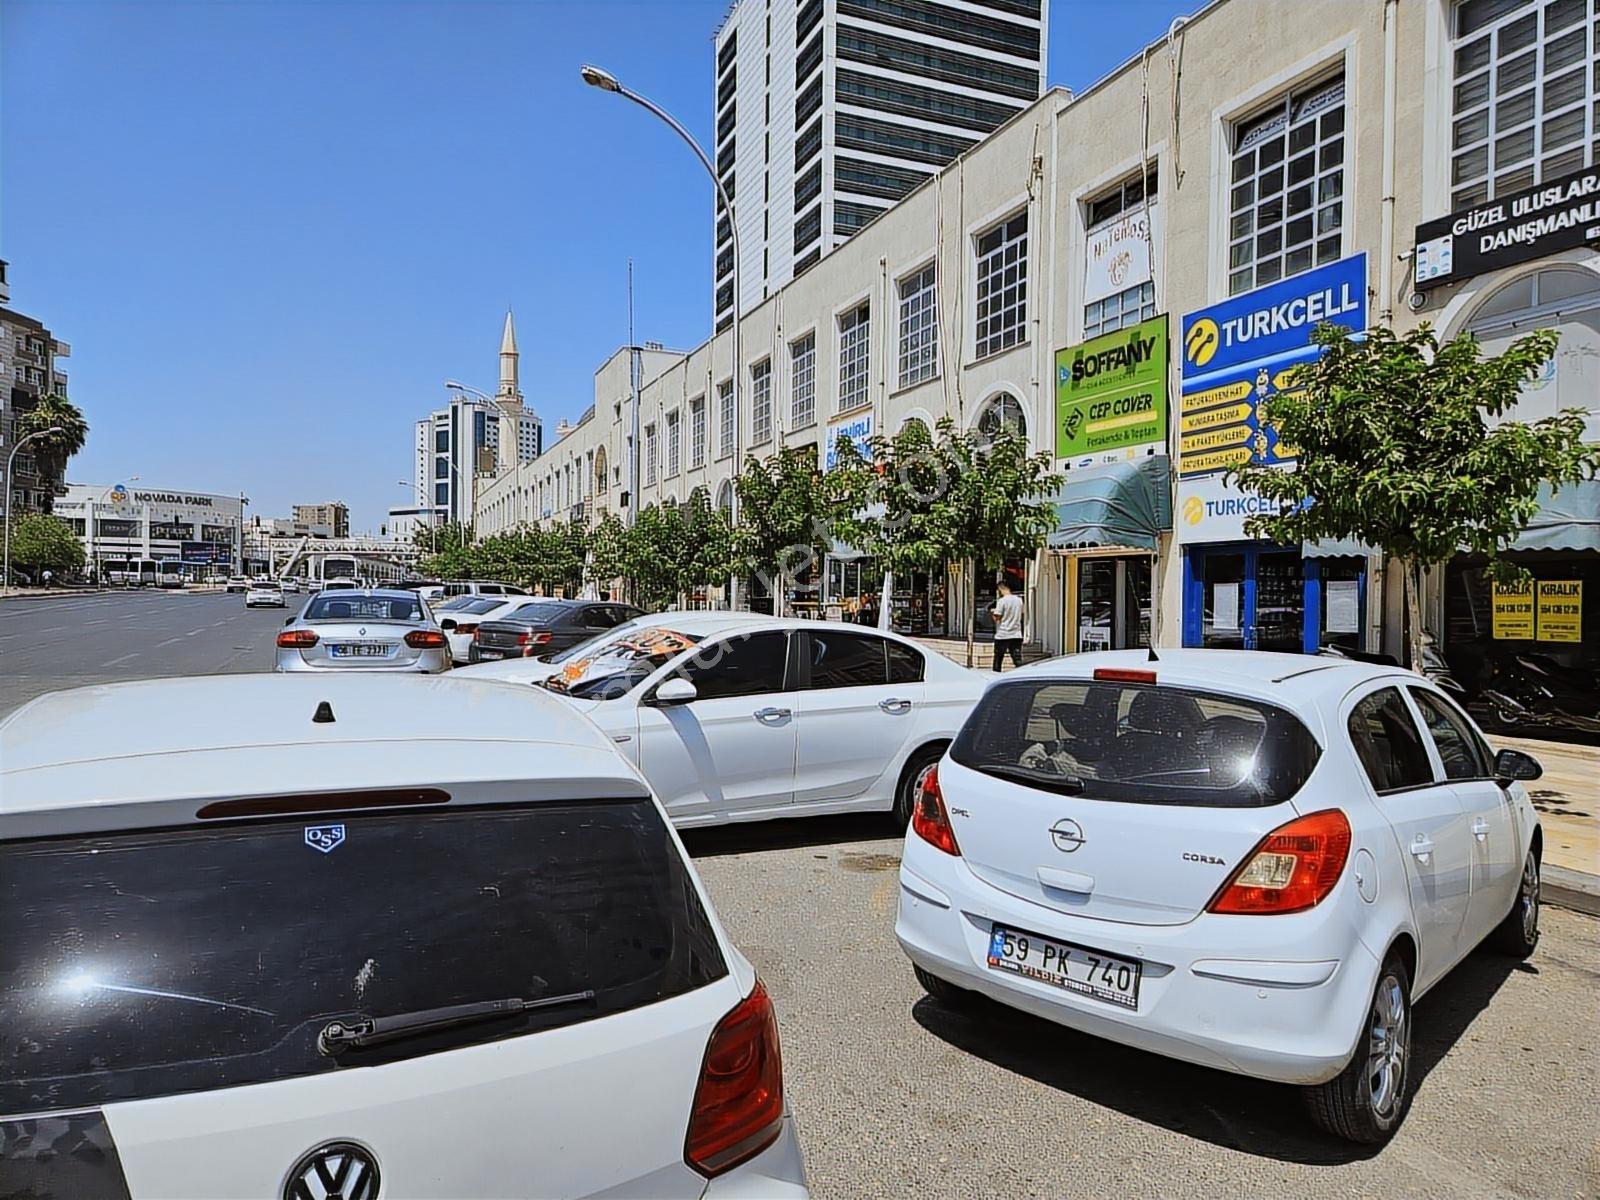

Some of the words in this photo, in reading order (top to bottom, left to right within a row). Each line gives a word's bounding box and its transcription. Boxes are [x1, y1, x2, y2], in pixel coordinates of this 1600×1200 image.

[1452, 204, 1508, 236] GÜZEL
[1222, 282, 1359, 347] TURKCELL
[1071, 336, 1157, 383] SOFFANY
[1089, 401, 1112, 420] CEP
[1113, 393, 1153, 415] COVER
[134, 492, 183, 505] NOVADA
[185, 496, 213, 507] PARK
[1182, 852, 1226, 865] CORSA
[1002, 934, 1029, 961] 59
[1043, 944, 1071, 975] PK
[1087, 956, 1131, 992] 740
